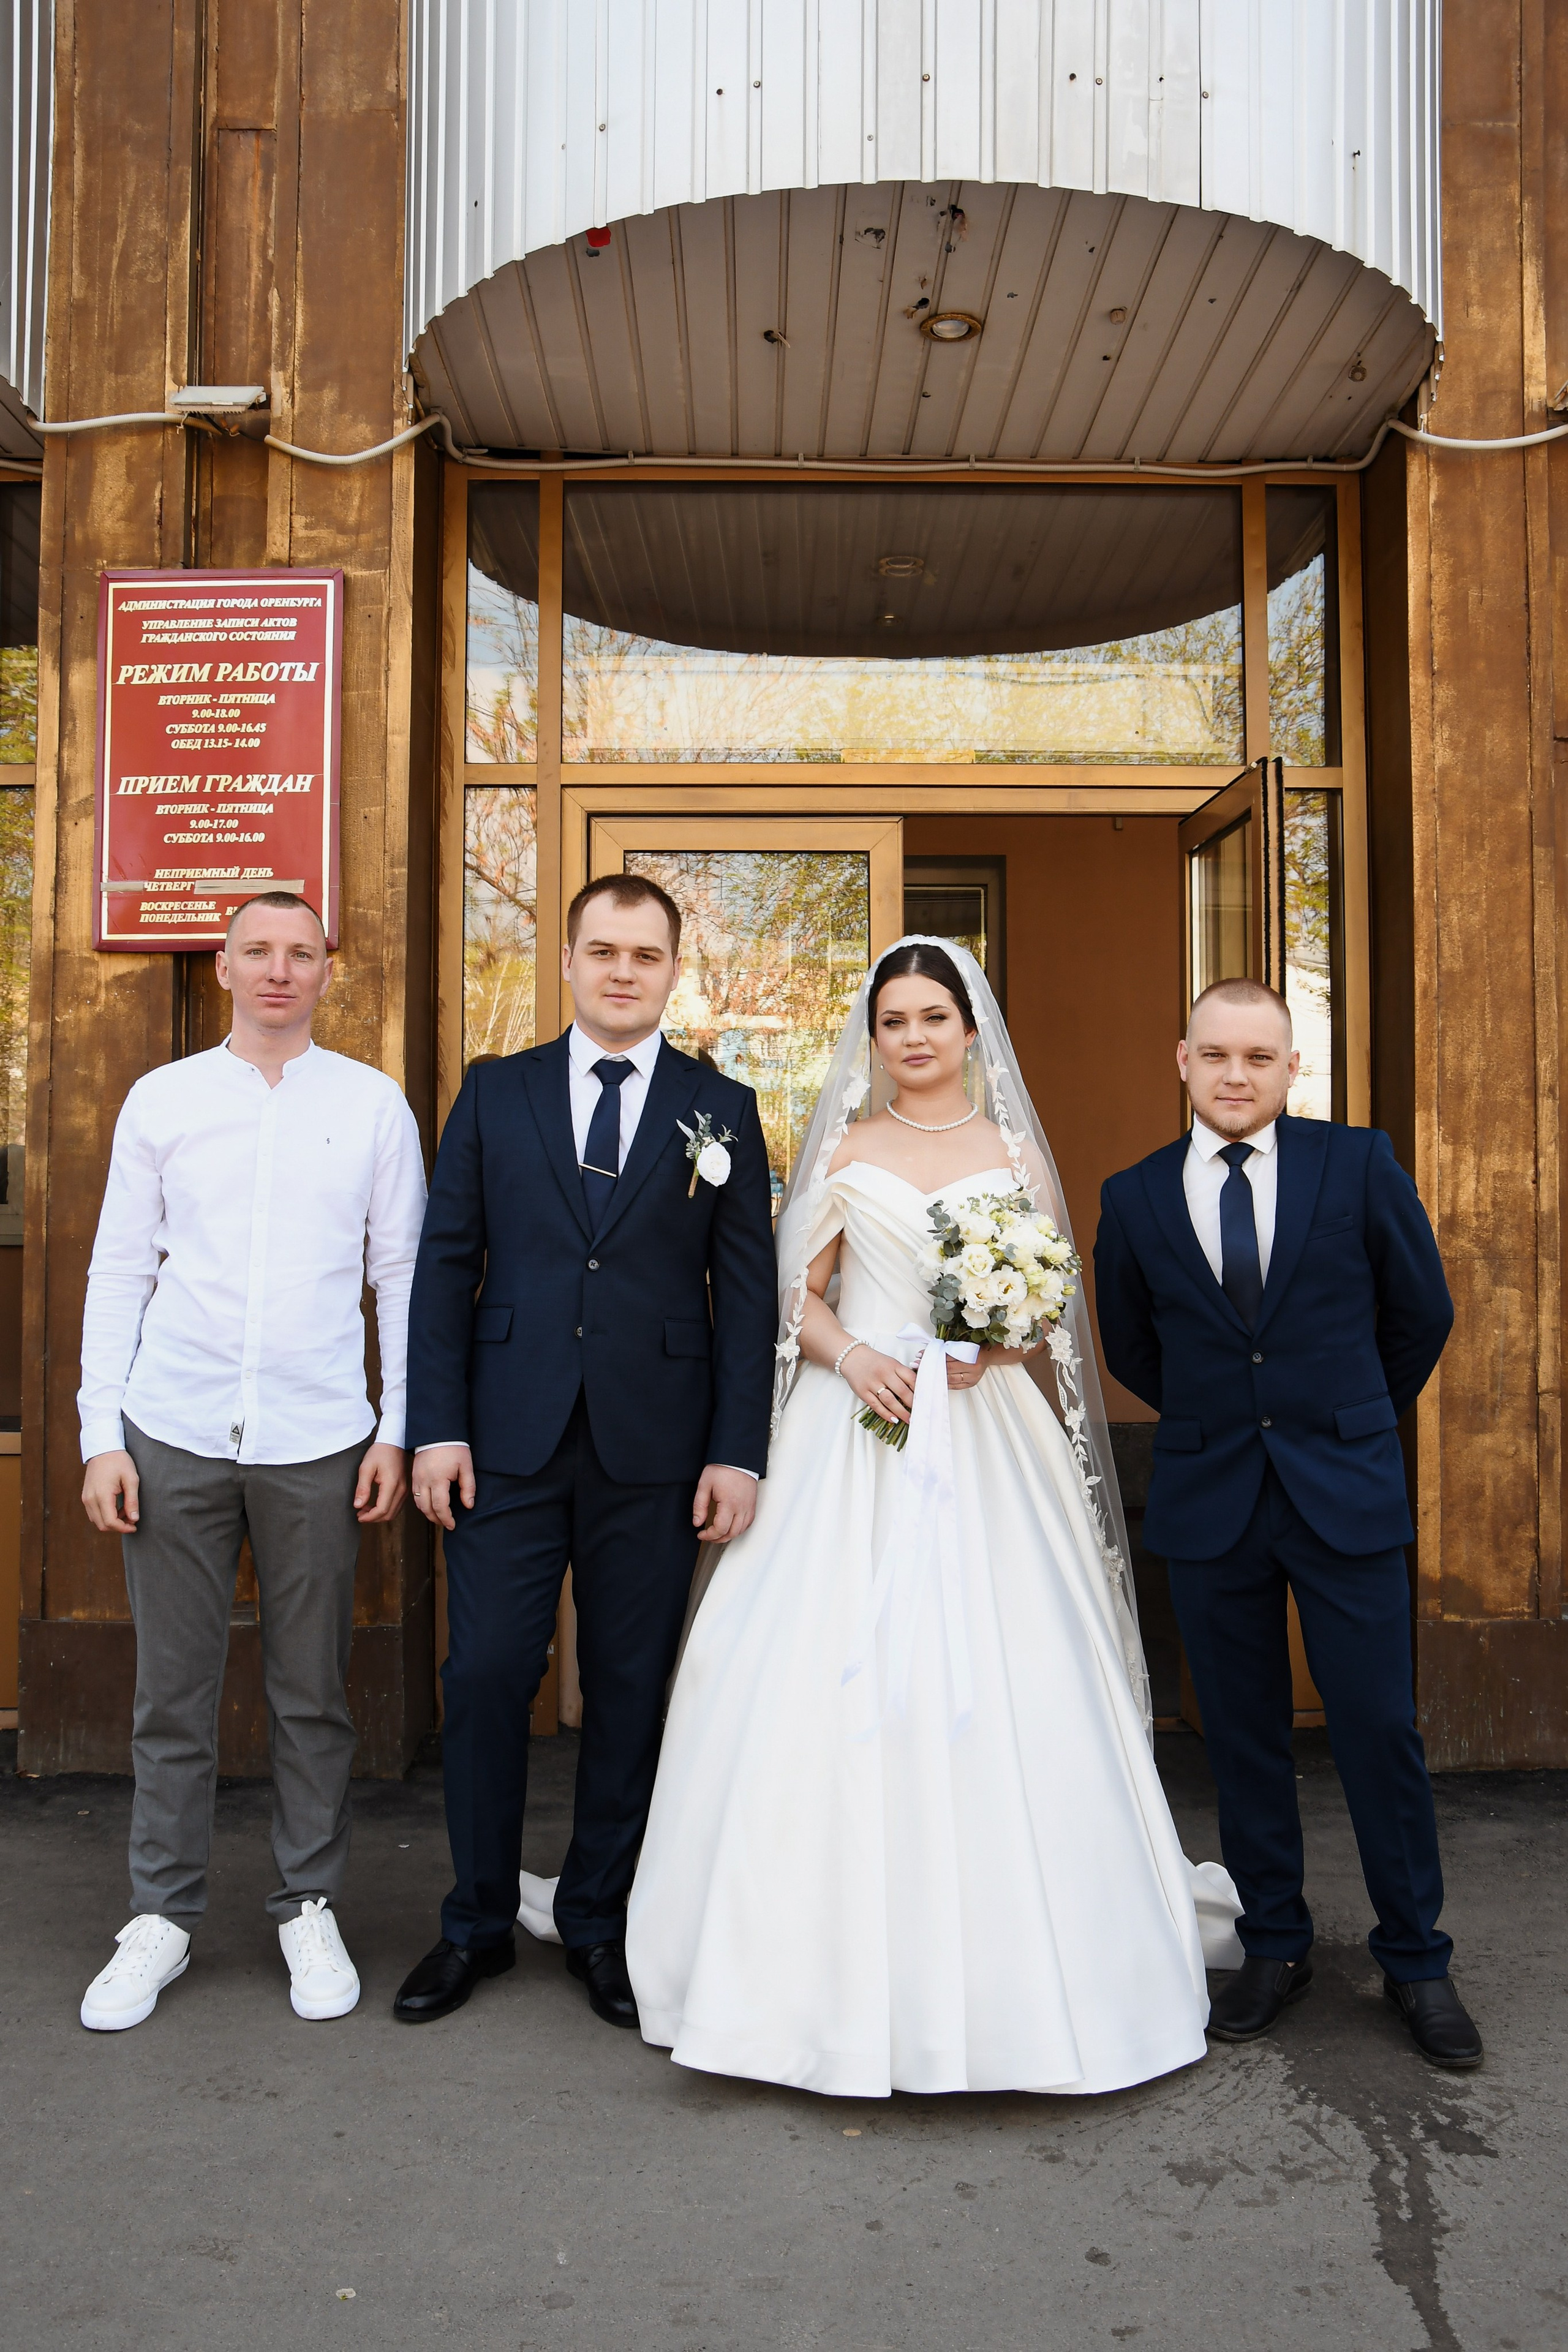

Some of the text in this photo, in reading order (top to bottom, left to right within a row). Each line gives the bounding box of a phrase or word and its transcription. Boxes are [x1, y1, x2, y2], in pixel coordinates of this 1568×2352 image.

[118, 598, 322, 612] АДМИНИСТРАЦИЯ ГОРОДА ОРЕНБУРГА
[141, 617, 297, 630] УПРАВЛЕНИЕ ЗАПИСИ АКТОВ
[141, 631, 297, 643] ГРАЖДАНСКОГО СОСТОЯНИЯ
[116, 662, 319, 685] РЕЖИМ РАБОТЫ
[158, 694, 212, 705] ВТОРНИК
[218, 693, 276, 704] ПЯТНИЦА
[192, 709, 241, 718] 9.00-18.00
[165, 723, 266, 734] СУББОТА 9.00-16.45
[172, 739, 201, 750] ОБЕД
[116, 774, 315, 796] ПРИЕМ ГРАЖДАН
[156, 804, 210, 815] ВТОРНИК
[216, 803, 274, 815] ПЯТНИЦА
[189, 820, 239, 829] 9.00-17.00
[164, 832, 265, 843] СУББОТА 9.00-16.00
[154, 866, 274, 880] НЕПРИЕМНЫЙ ДЕНЬ
[144, 881, 194, 891] ЧЕТВЕРГ
[140, 901, 216, 911] ВОСКРЕСЕНЬЕ
[140, 913, 221, 924] ПОНЕДЕЛЬНИК
